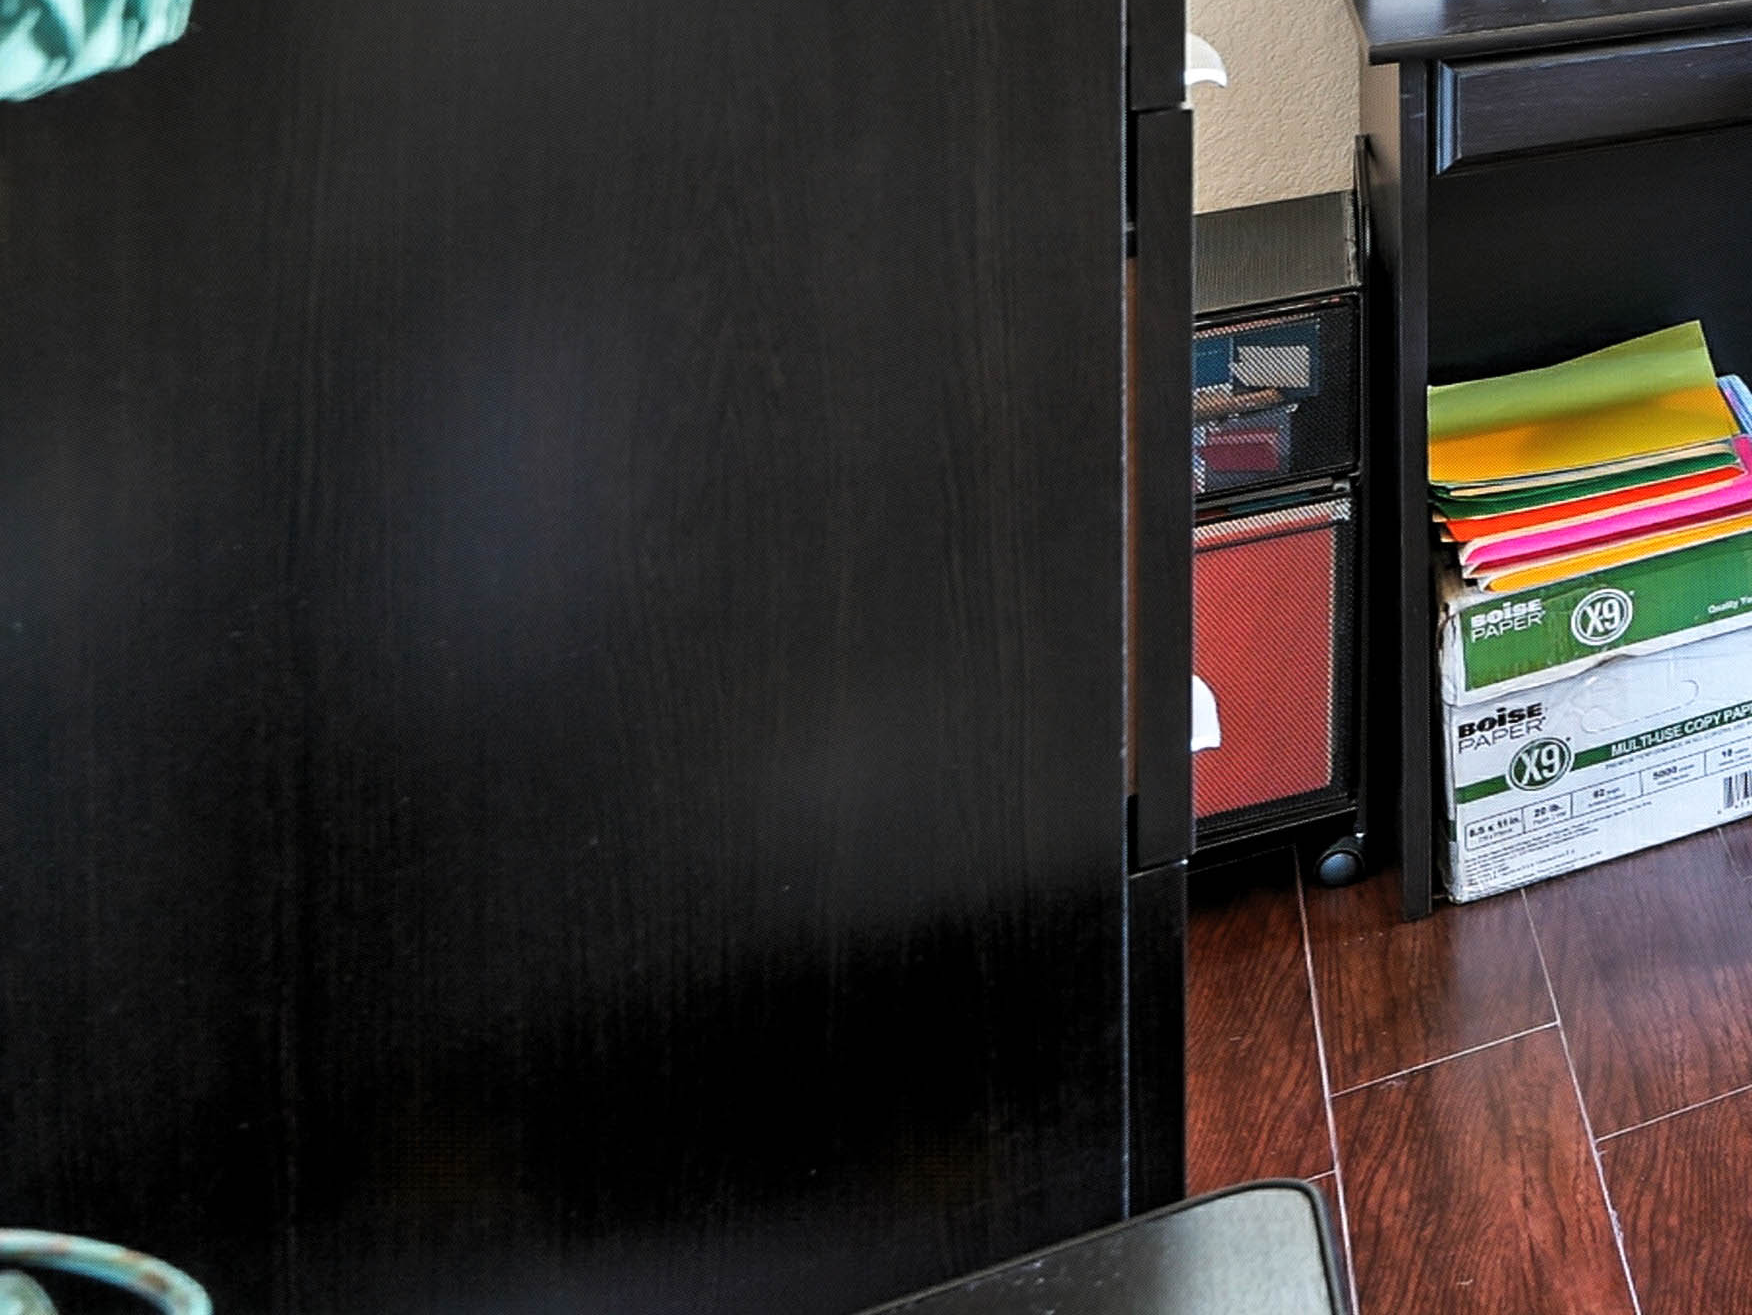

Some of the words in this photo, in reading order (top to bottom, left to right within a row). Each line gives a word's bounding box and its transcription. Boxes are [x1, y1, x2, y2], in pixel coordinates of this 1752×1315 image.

[1471, 610, 1544, 643] PAPER
[1458, 718, 1544, 755] PAPER
[1611, 724, 1683, 758] MULTI-USE
[1684, 711, 1722, 734] COPY
